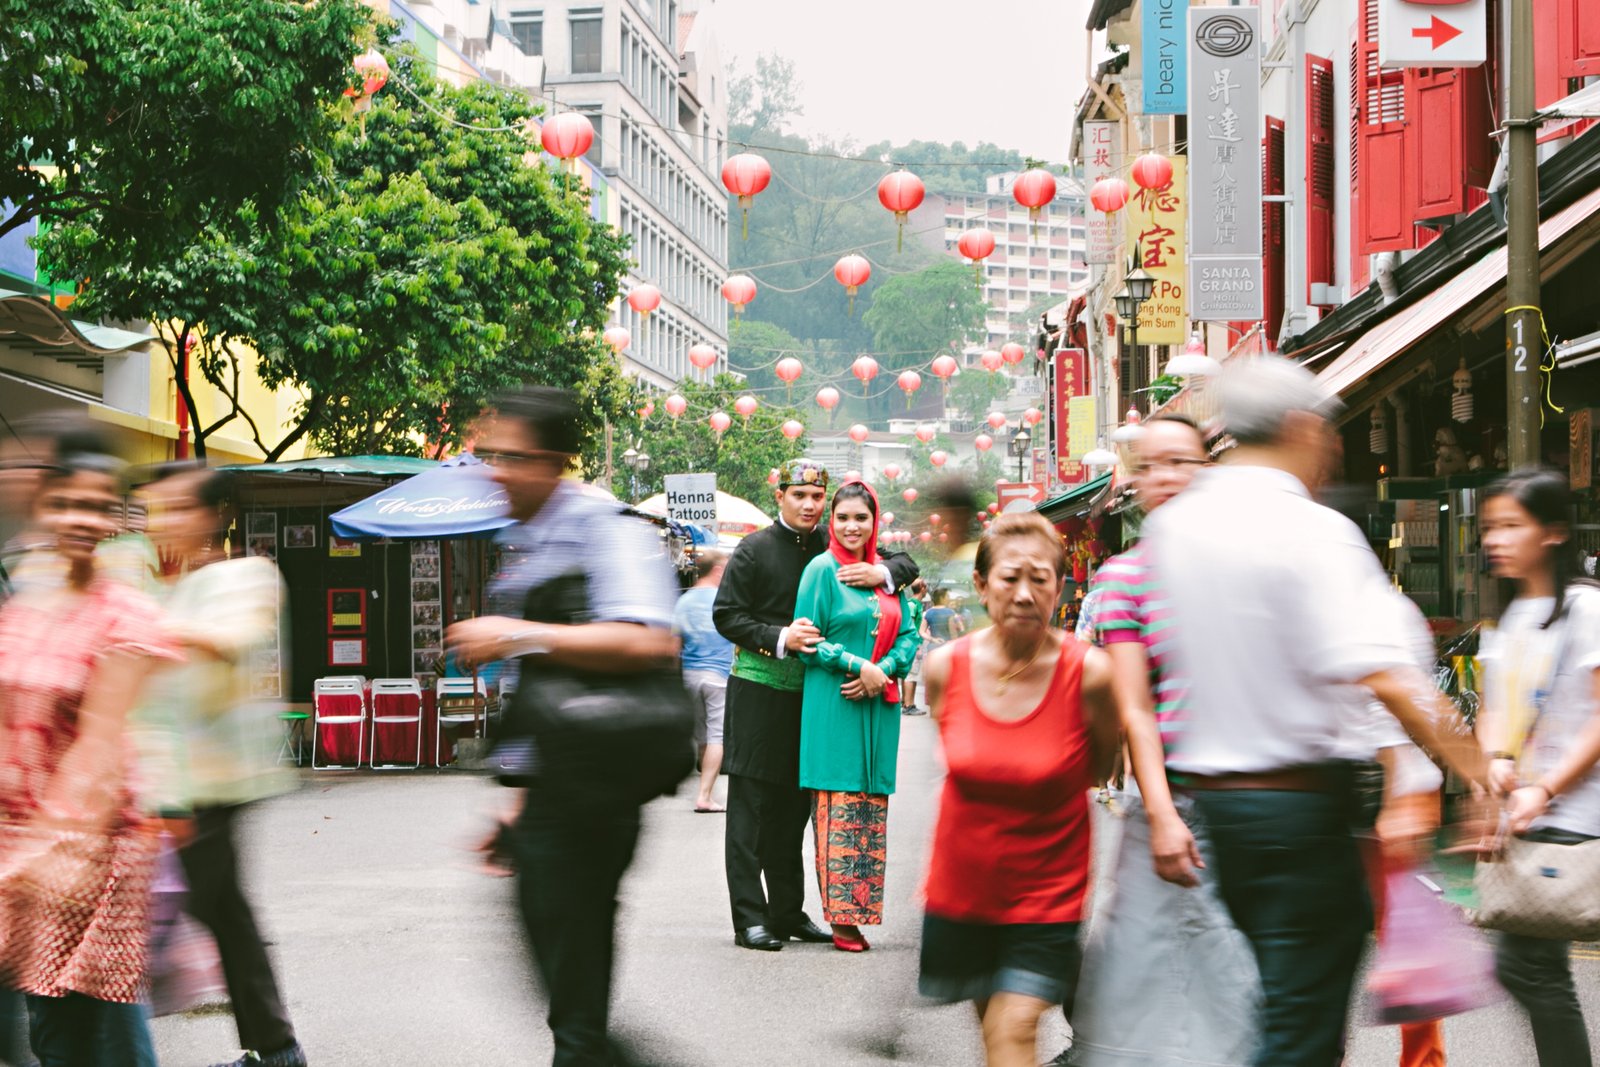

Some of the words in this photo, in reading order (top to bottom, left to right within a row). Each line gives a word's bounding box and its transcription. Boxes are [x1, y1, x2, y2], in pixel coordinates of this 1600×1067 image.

[1155, 37, 1178, 95] beary
[1202, 267, 1251, 279] SANTA
[1161, 281, 1182, 299] Po
[1200, 280, 1254, 291] GRAND
[1138, 305, 1154, 316] ong
[1157, 304, 1181, 316] Kong
[1156, 318, 1176, 328] Sum
[375, 497, 441, 516] World
[440, 489, 510, 513] Acclaim
[667, 491, 714, 504] Henna
[668, 508, 716, 520] Tattoos
